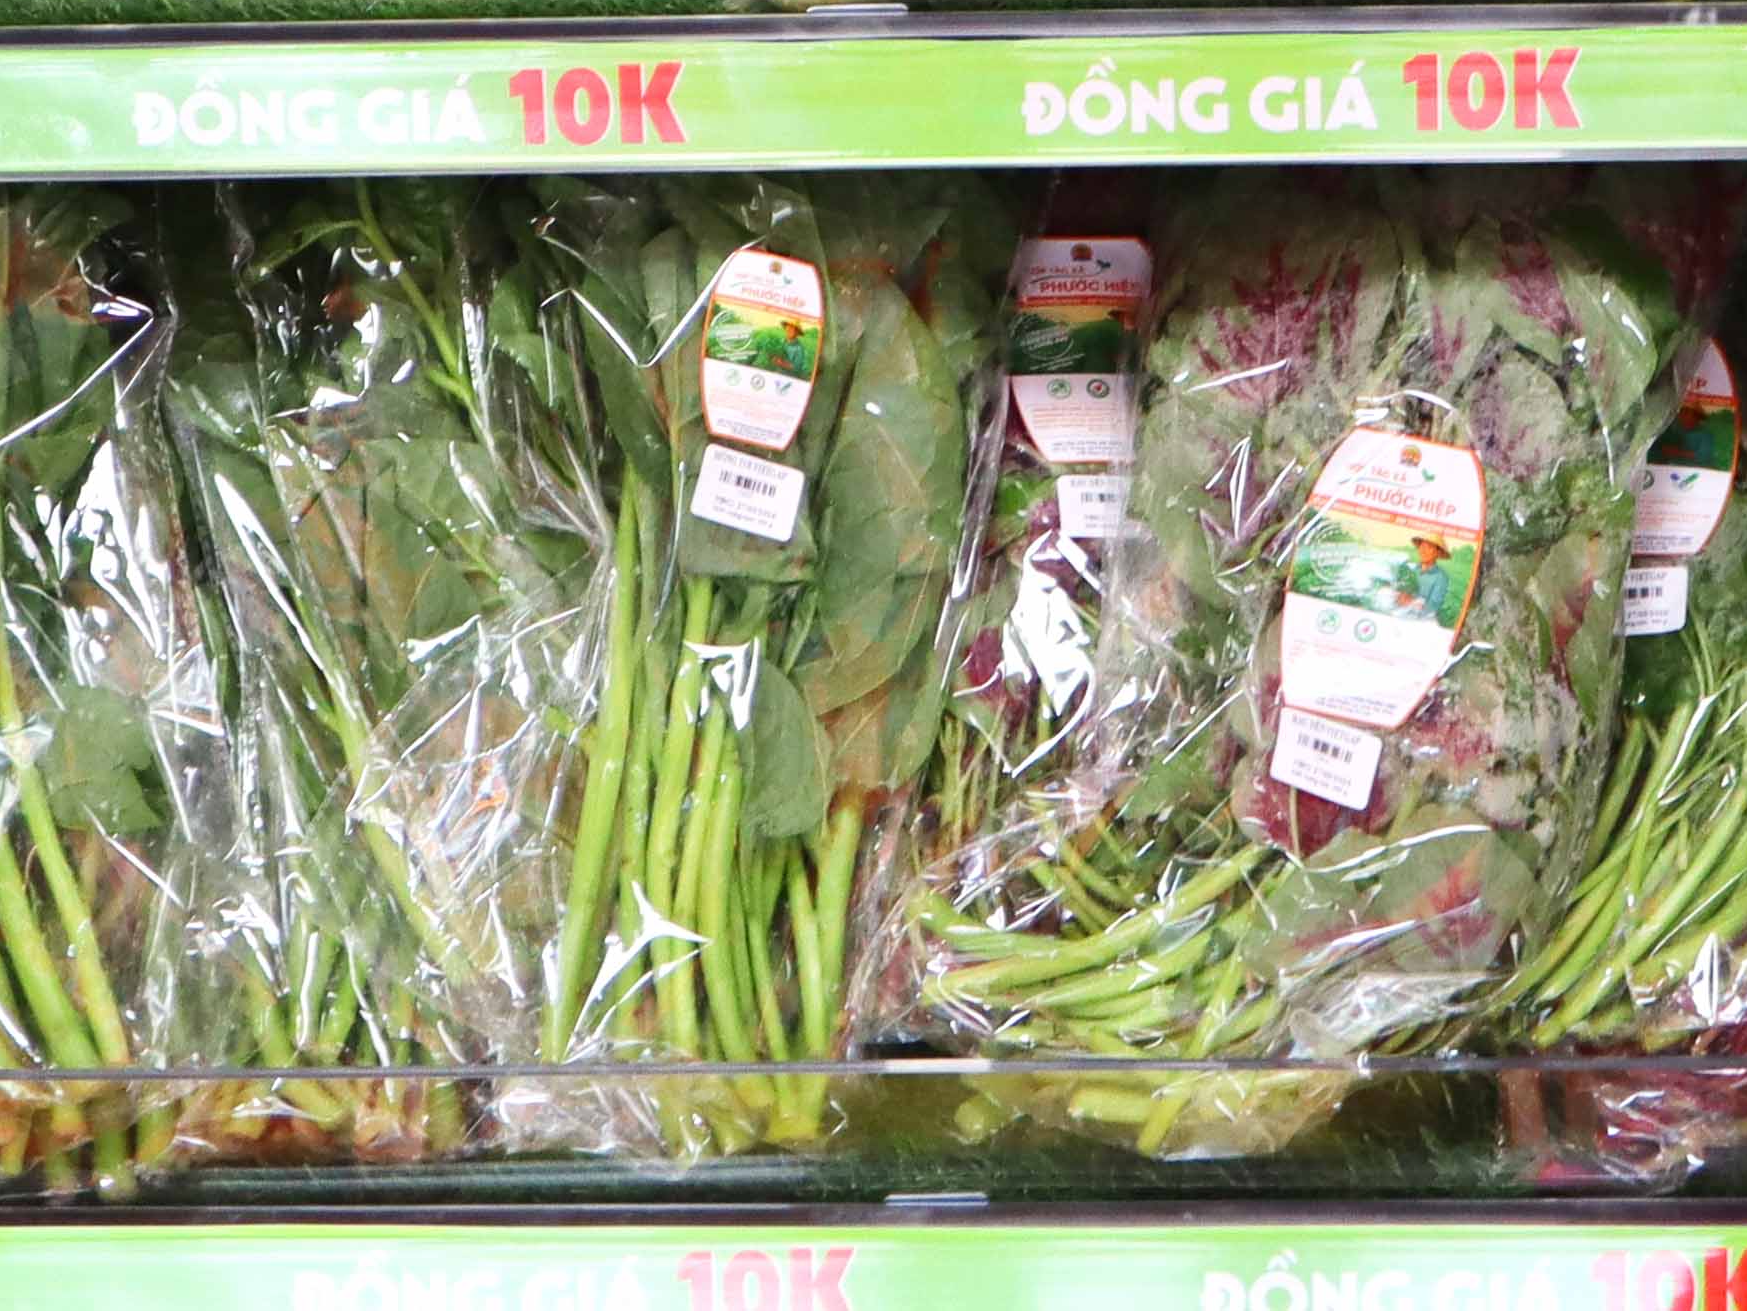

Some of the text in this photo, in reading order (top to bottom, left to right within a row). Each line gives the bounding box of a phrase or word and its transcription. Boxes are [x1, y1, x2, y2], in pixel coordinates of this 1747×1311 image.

[132, 60, 689, 147] ĐỒNG GIÁ 10K
[1022, 47, 1584, 136] ĐỒNG GIÁ 10K
